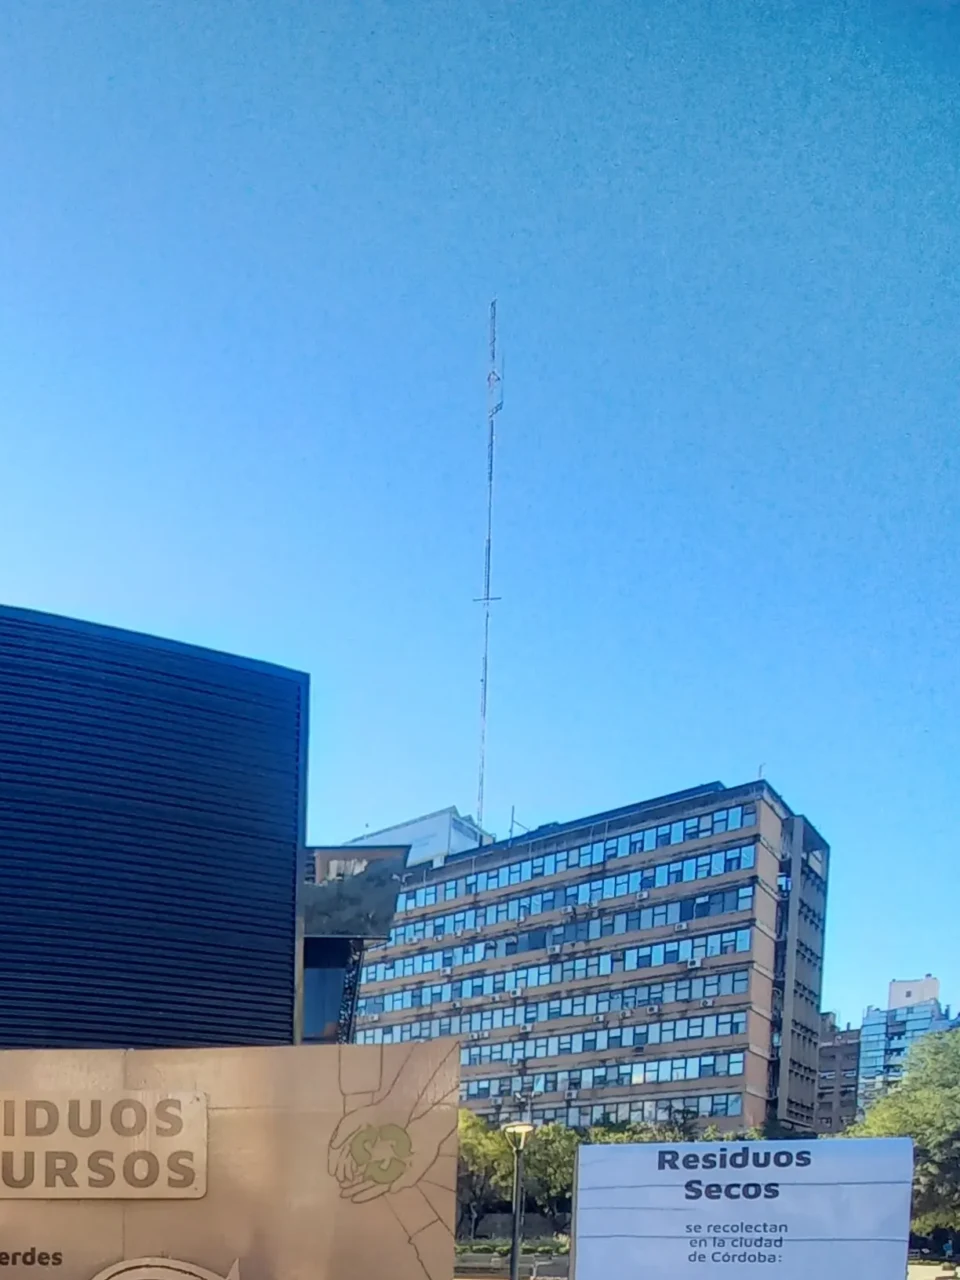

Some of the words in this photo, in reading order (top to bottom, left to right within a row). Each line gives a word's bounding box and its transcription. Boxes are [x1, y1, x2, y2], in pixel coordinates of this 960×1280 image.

[657, 1147, 812, 1171] Residuos
[684, 1179, 780, 1200] Secos
[686, 1223, 702, 1233] se
[707, 1222, 789, 1234] recolectan
[689, 1238, 707, 1248] en
[713, 1236, 726, 1248] la
[730, 1236, 783, 1249] ciudad
[688, 1251, 707, 1263] de
[711, 1251, 783, 1263] Córdoba:
